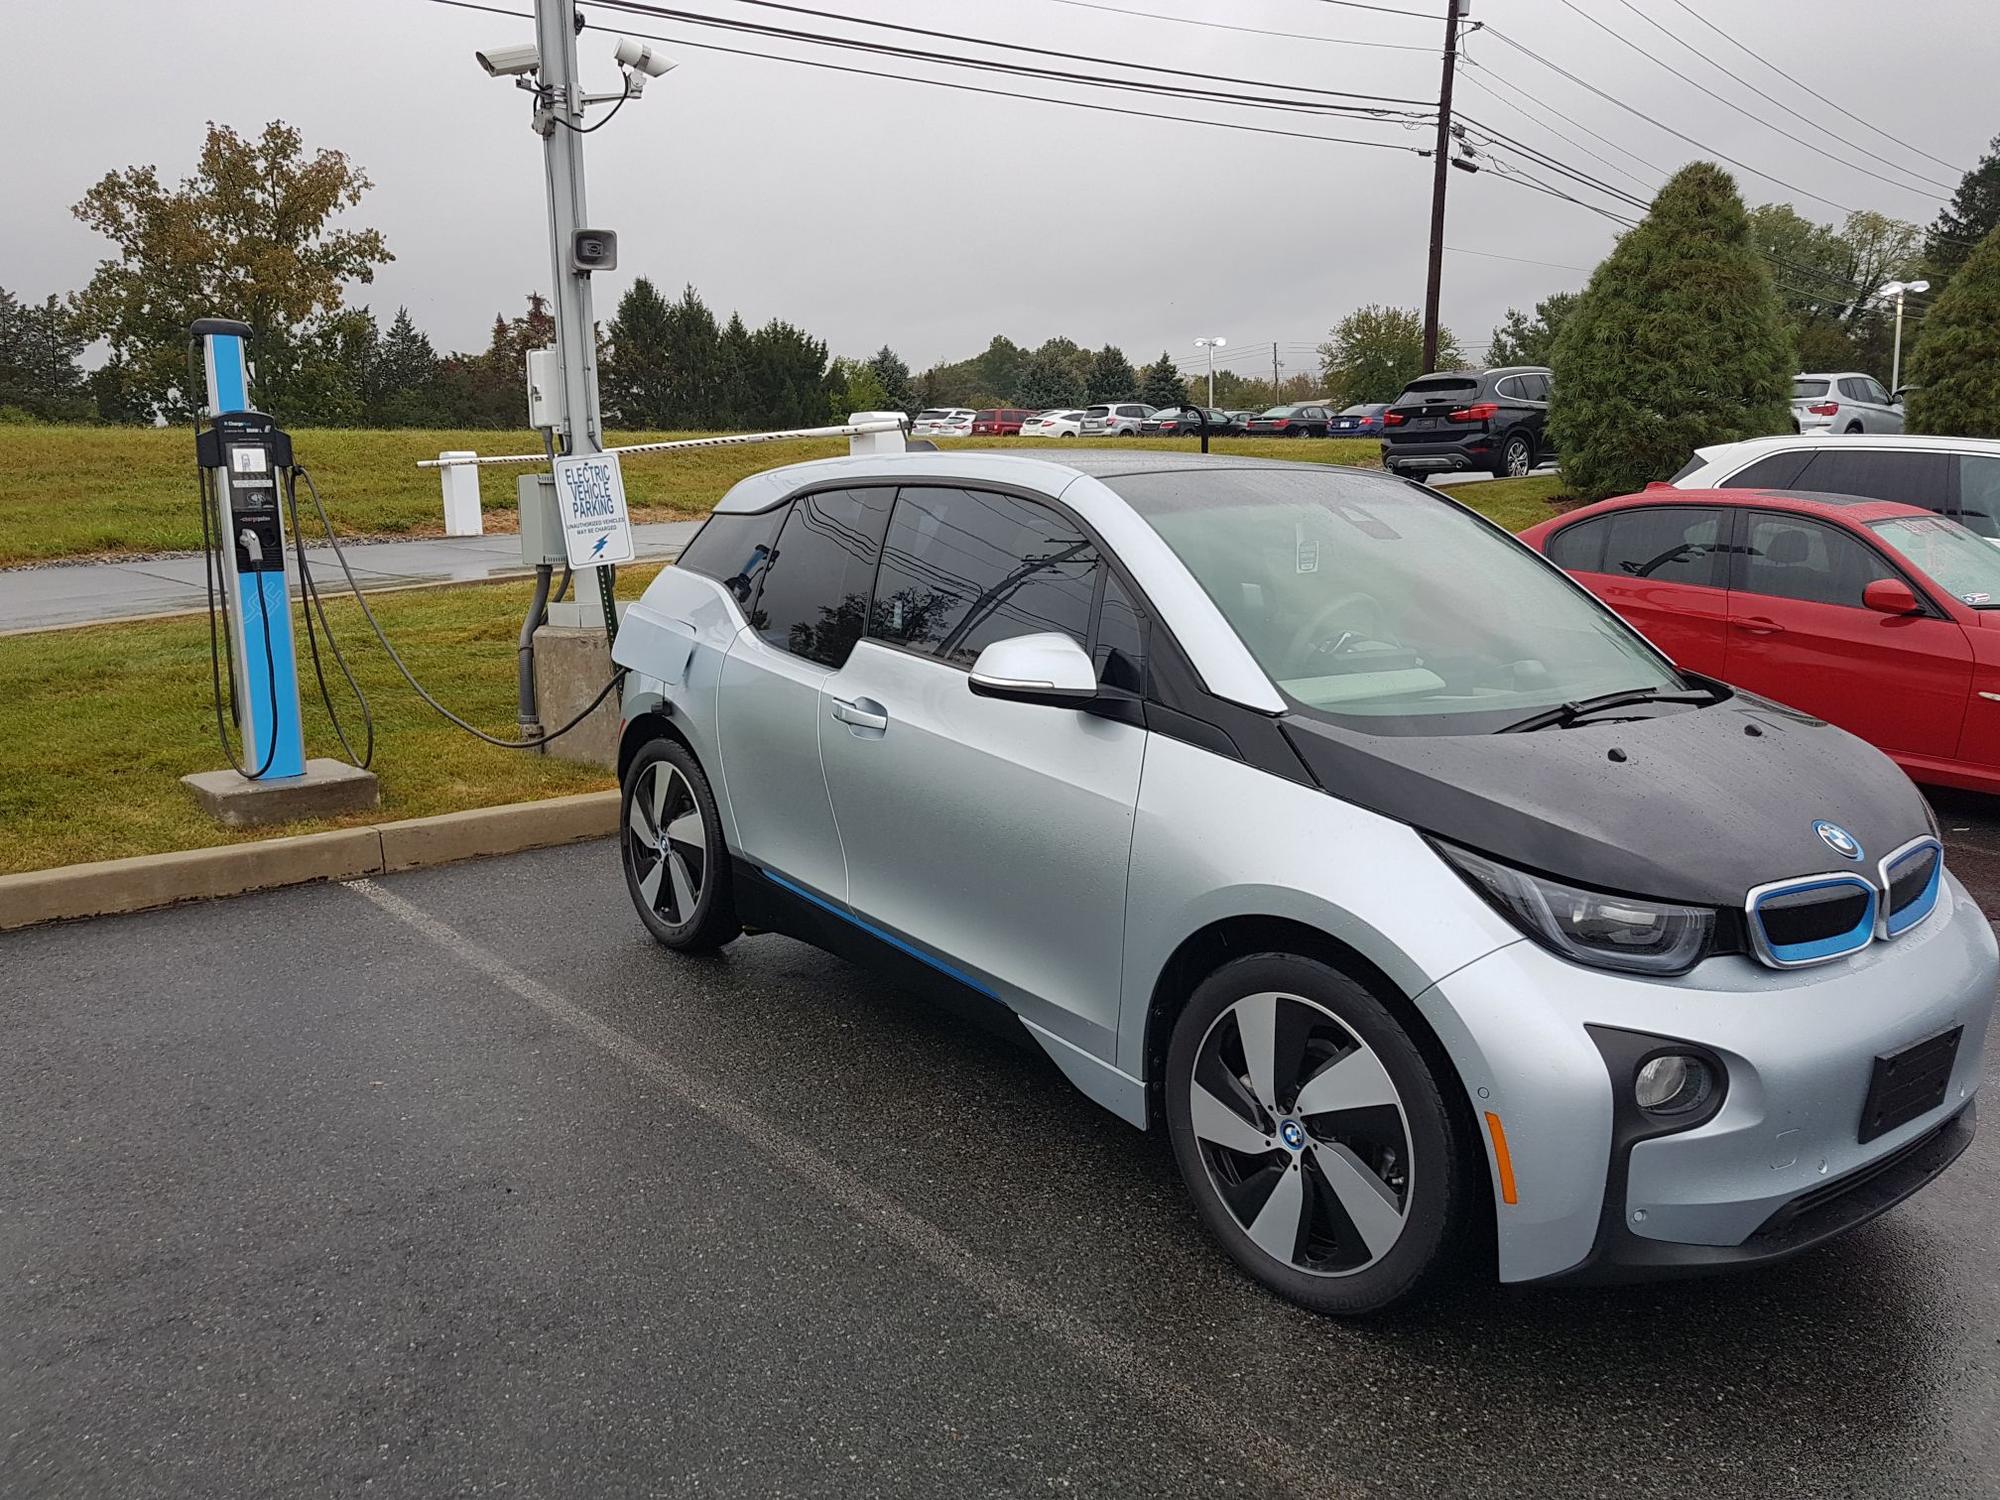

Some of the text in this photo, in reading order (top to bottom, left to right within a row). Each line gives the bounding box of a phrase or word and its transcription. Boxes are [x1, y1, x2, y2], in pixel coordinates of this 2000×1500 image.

[565, 465, 610, 485] ELECTRIC
[570, 481, 610, 501] VEHICLE
[573, 498, 614, 519] PARKING
[595, 525, 616, 533] CHARGED
[603, 517, 625, 525] VEHICLES
